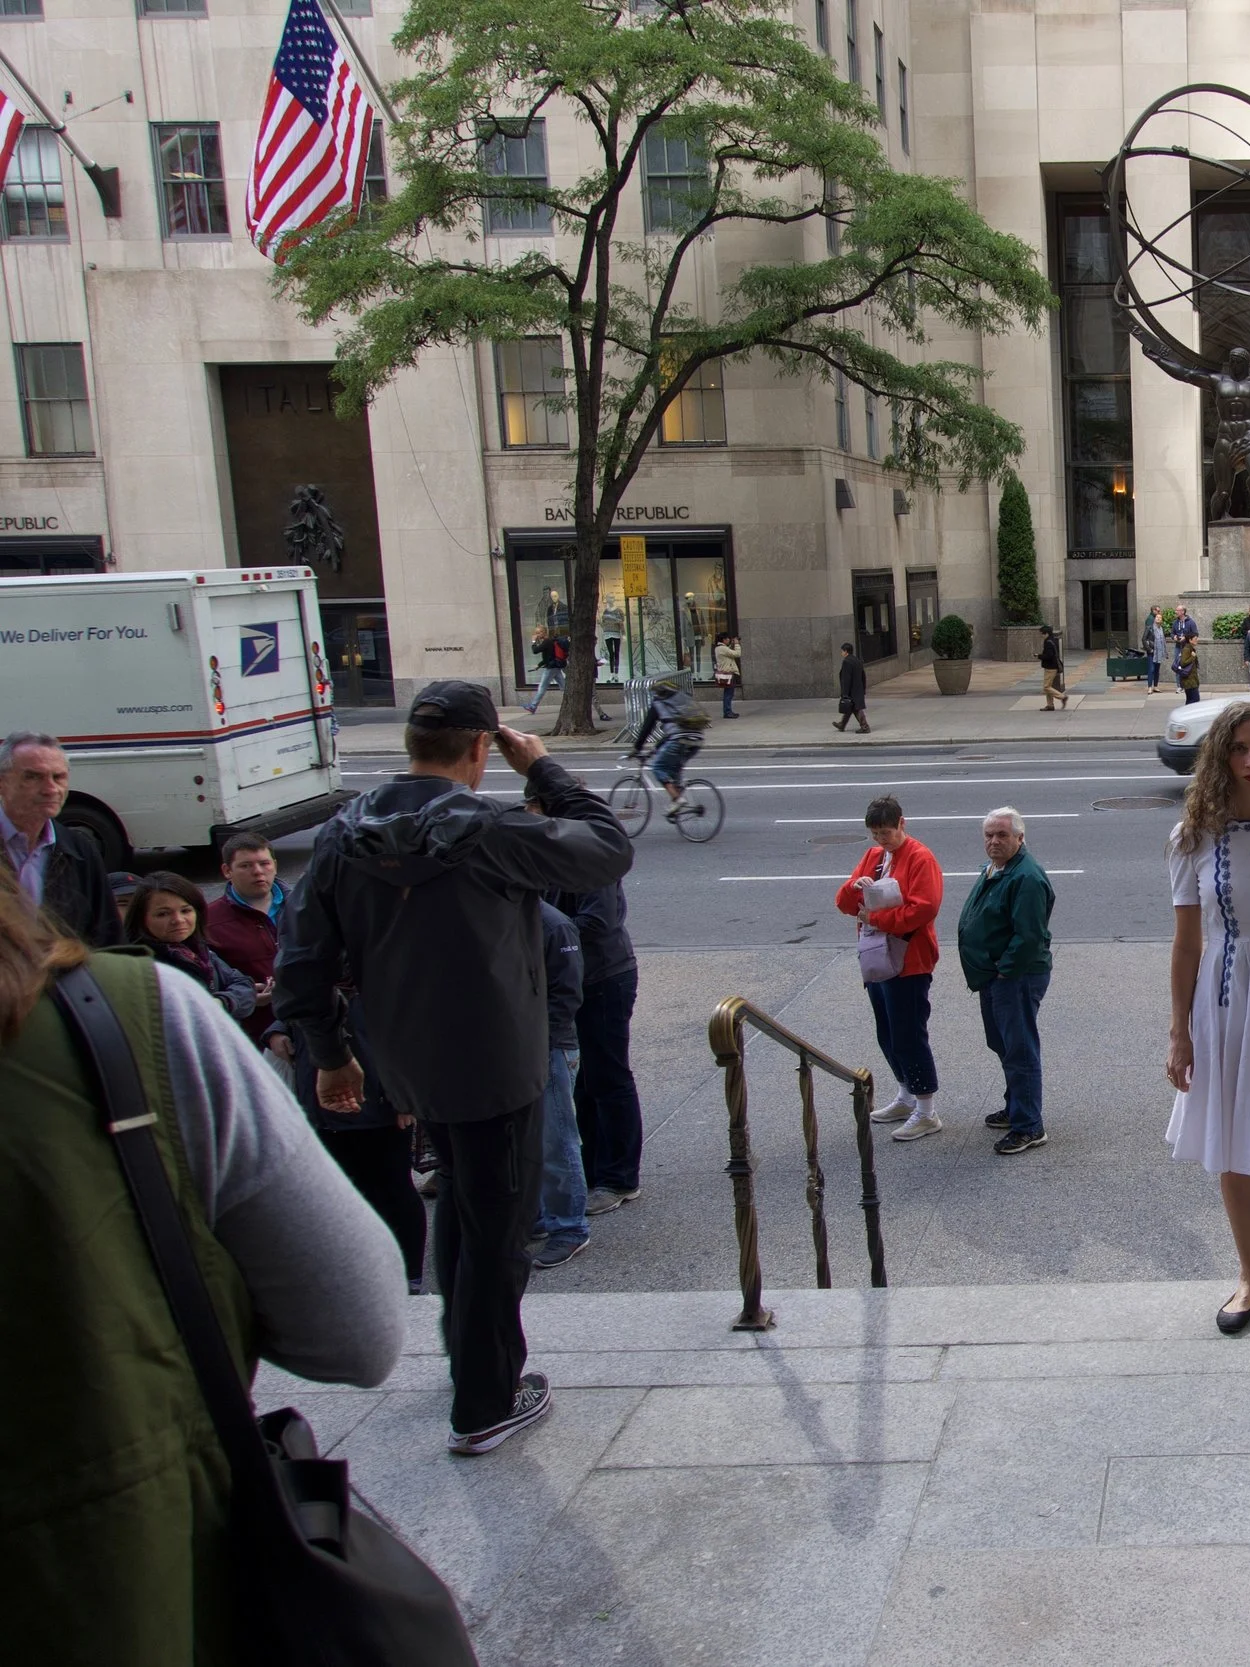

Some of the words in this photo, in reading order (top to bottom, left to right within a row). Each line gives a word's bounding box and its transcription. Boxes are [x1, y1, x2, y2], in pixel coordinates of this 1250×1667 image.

[243, 384, 336, 414] ITALI
[616, 506, 690, 520] REPUBLIC
[0, 630, 25, 644] We
[28, 628, 84, 643] Deliver
[87, 626, 113, 640] For
[115, 625, 149, 640] You.
[116, 704, 193, 715] www.usps.com
